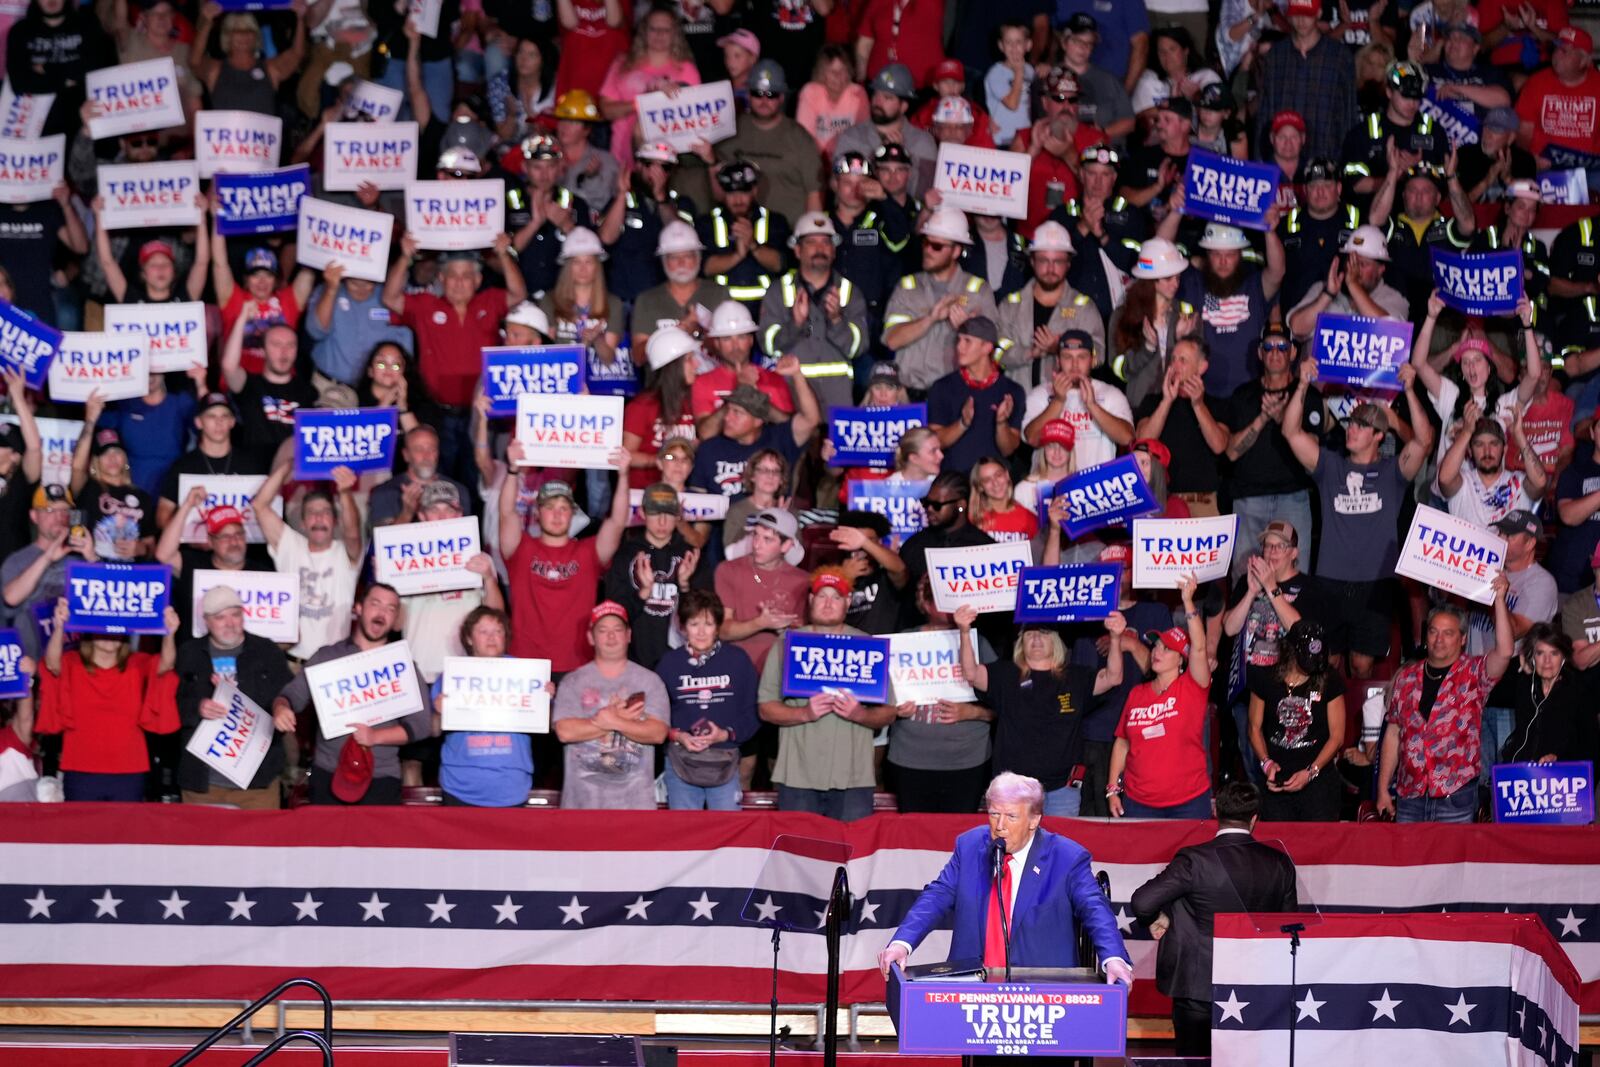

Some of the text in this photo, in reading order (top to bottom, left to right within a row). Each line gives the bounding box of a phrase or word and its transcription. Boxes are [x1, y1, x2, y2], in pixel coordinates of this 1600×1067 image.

[93, 77, 169, 100] TRUMP
[103, 94, 164, 113] VANCE
[646, 99, 727, 122] TRUMP
[1548, 100, 1592, 113] TRUMP
[659, 115, 720, 133] VANCE
[1420, 99, 1480, 145] TRUMP
[204, 128, 277, 145] TRUMP
[212, 145, 271, 158] VANCE
[334, 140, 411, 155] TRUMP
[0, 152, 58, 169] RUMP
[343, 155, 402, 168] VANCE
[0, 168, 49, 181] ANCE
[945, 161, 1021, 184] TRUMP
[1191, 164, 1271, 194] TRUMP
[107, 178, 191, 195] TRUMP
[219, 182, 305, 203] TRUMP
[950, 178, 1012, 196] VANCE
[117, 191, 182, 206] VANCE
[414, 197, 496, 213] TRUMP
[1196, 184, 1260, 208] VANCE
[230, 200, 294, 216] VANCE
[0, 222, 43, 234] RUMP
[423, 213, 488, 225] VANCE
[306, 216, 383, 242] TRUMP
[312, 235, 371, 256] VANCE
[1436, 260, 1517, 282] TRUMP
[1444, 279, 1510, 297] VANCE
[0, 317, 53, 358] UMP
[150, 338, 190, 350] NCE
[1320, 328, 1404, 353] TRUMP
[59, 350, 140, 365] TRUMP
[1328, 345, 1394, 366] VANCE
[66, 365, 131, 378] VANCE
[488, 363, 578, 380] TRUMP
[500, 379, 570, 394] VANCE
[526, 413, 615, 430] TRUMP
[1063, 410, 1091, 423] RUM
[300, 424, 391, 444] TRUMP
[534, 430, 604, 444] VANCE
[844, 437, 899, 449] VANC
[311, 439, 382, 457] VANCE
[1065, 472, 1138, 507] RUMP
[204, 494, 257, 508] RUM
[854, 496, 922, 514] TRUM
[1070, 487, 1138, 518] VANCE
[384, 536, 471, 562] TRUMP
[1141, 534, 1229, 553] TRUMP
[1418, 524, 1500, 565] TRUMP
[395, 554, 463, 572] VANCE
[1152, 551, 1218, 566] VANCE
[1422, 543, 1488, 578] VANCE
[71, 578, 164, 598] TRUMP
[948, 577, 1017, 593] VANCE
[1024, 574, 1115, 595] TRUMP
[81, 596, 154, 611] VANCE
[1033, 588, 1104, 603] VANCE
[241, 607, 283, 620] NCE
[1057, 613, 1075, 622] 2024
[790, 646, 884, 664] TRUMP
[890, 650, 955, 668] RUM
[802, 662, 873, 678] VANCE
[893, 667, 962, 682] VANCE
[320, 662, 406, 698] TRUMP
[453, 676, 542, 693] TRUMP
[679, 675, 730, 689] Trump
[334, 680, 402, 710] VANCE
[461, 694, 531, 708] VANCE
[1129, 697, 1177, 721] TRUMP
[207, 693, 244, 760] TRUMP
[224, 709, 256, 759] VANCE
[1498, 777, 1587, 799] TRUMP
[1508, 793, 1577, 811] VANCE
[928, 993, 1100, 1005] TEXT PENNSYLVANIA TO 88022
[961, 1004, 1066, 1024] TRUMP
[972, 1023, 1054, 1039] VANCE
[996, 1045, 1029, 1055] 2024
